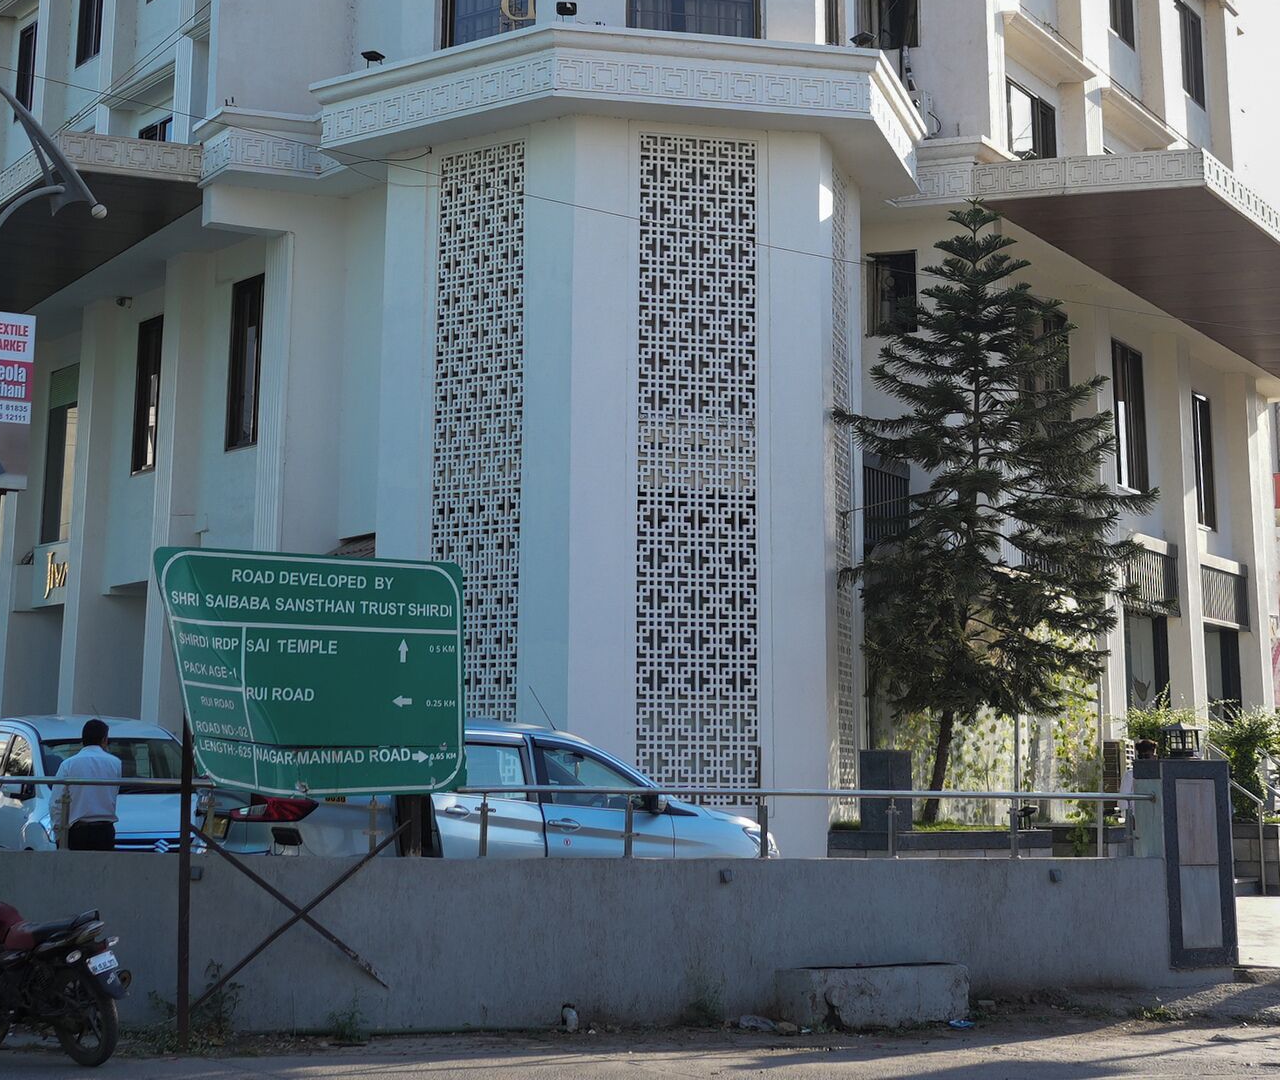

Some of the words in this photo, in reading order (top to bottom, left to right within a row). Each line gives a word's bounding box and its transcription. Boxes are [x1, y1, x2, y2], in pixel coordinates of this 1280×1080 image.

[232, 569, 275, 585] ROAD
[279, 571, 367, 589] DEVELOPED
[374, 576, 394, 590] BY
[171, 591, 200, 607] SHRI
[205, 594, 271, 611] SAIBABA
[275, 597, 355, 614] SANSTHAN
[359, 600, 406, 616] TRUST
[408, 602, 452, 617] SHIRDI
[179, 633, 209, 648] SHIRDI
[212, 638, 239, 650] IRDP
[246, 639, 270, 653] SAI
[278, 640, 338, 655] TEMPLE
[246, 687, 268, 701] RUI
[272, 688, 315, 702] ROAD
[201, 696, 214, 706] RUI
[215, 698, 234, 710] ROAD
[196, 721, 220, 733] ROAD
[370, 748, 410, 762] ROAD
